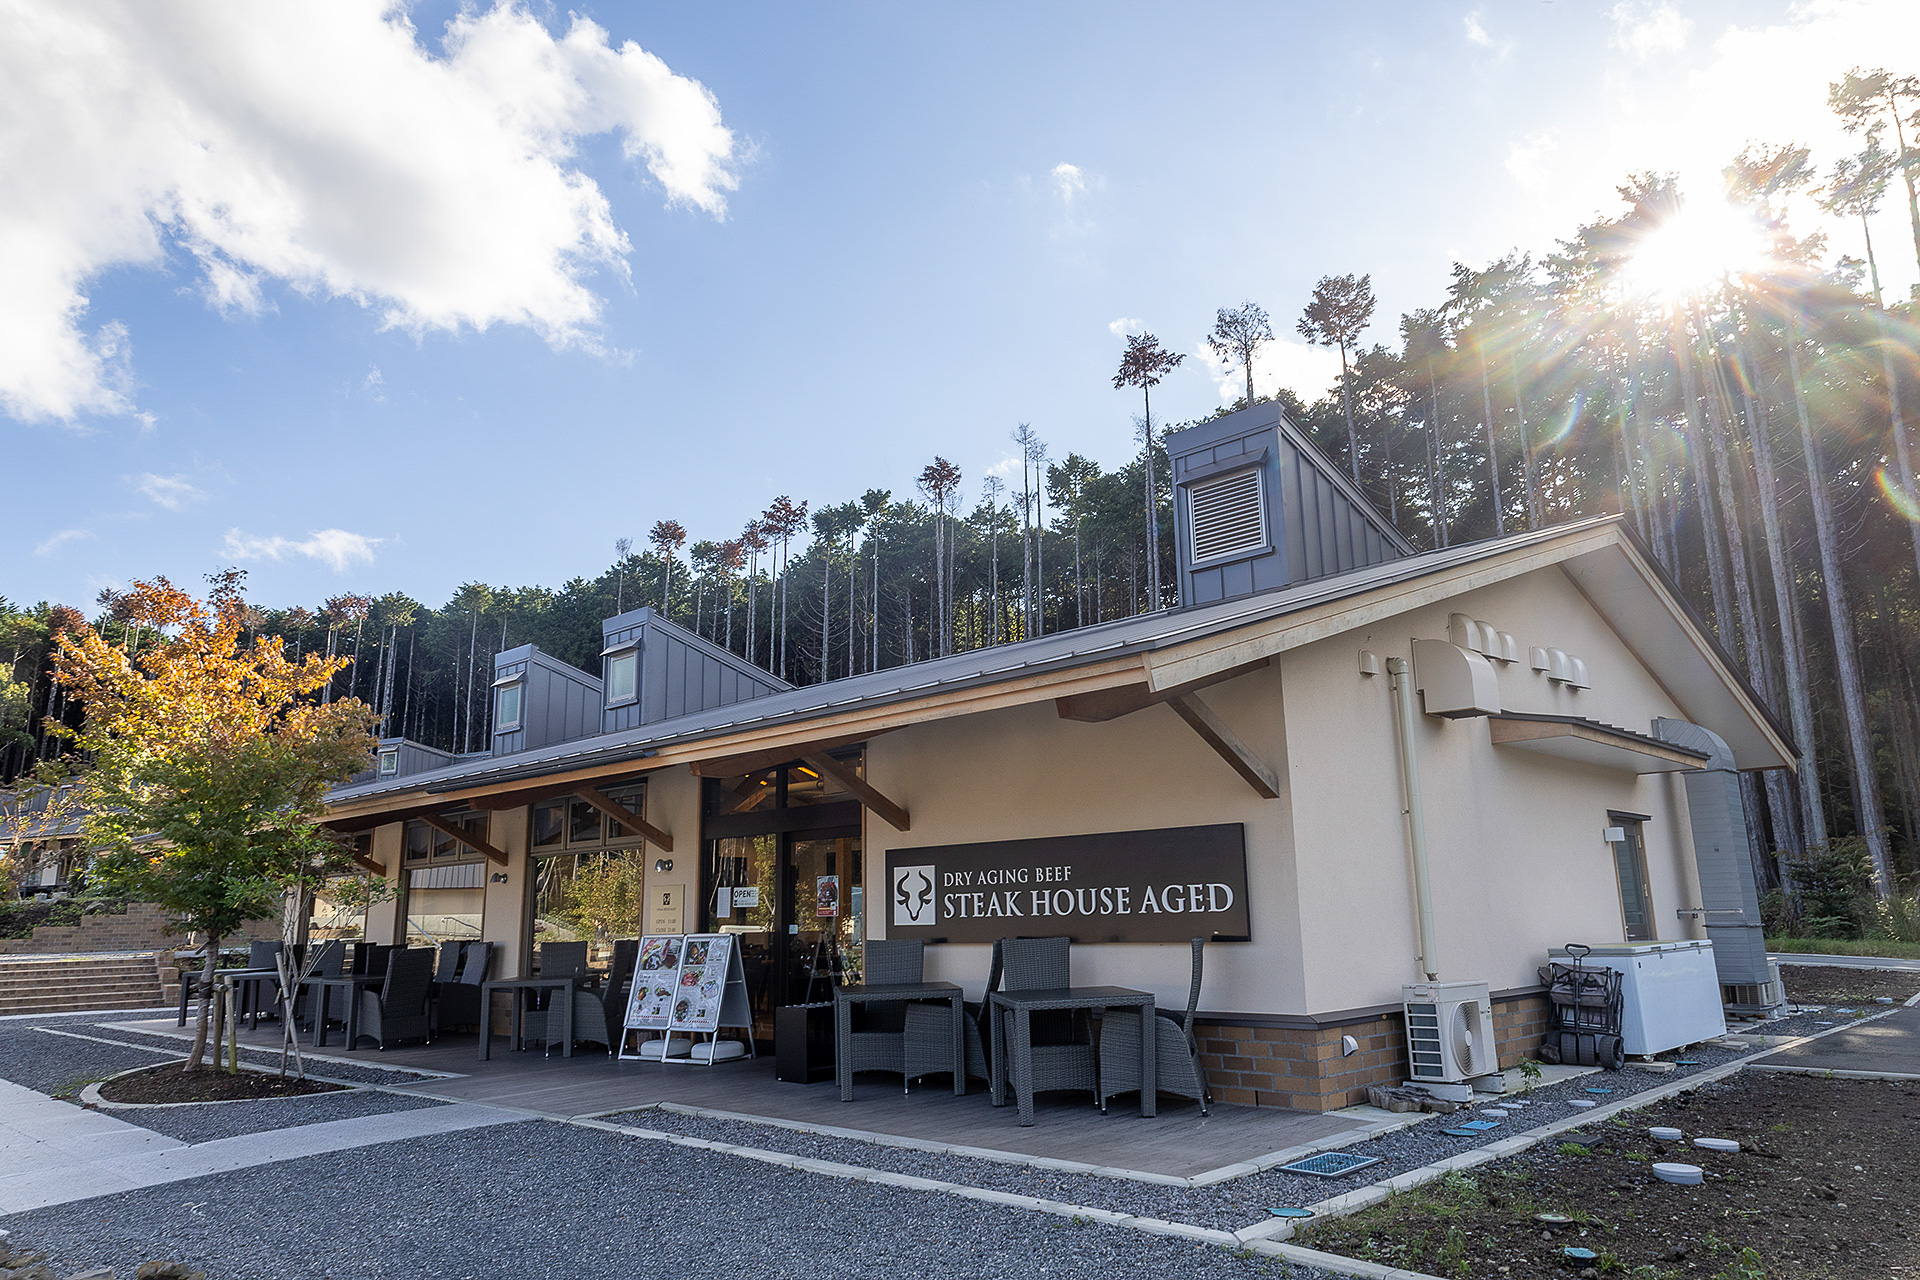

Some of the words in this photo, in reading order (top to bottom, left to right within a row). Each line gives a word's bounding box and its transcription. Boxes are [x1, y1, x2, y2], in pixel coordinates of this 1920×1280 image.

[944, 871, 973, 887] DRY
[977, 868, 1028, 885] AGING
[1035, 866, 1072, 882] BEEF
[734, 890, 751, 898] OPEN
[943, 891, 1023, 918] STEAK
[1030, 888, 1131, 916] HOUSE
[1138, 883, 1235, 914] AGED
